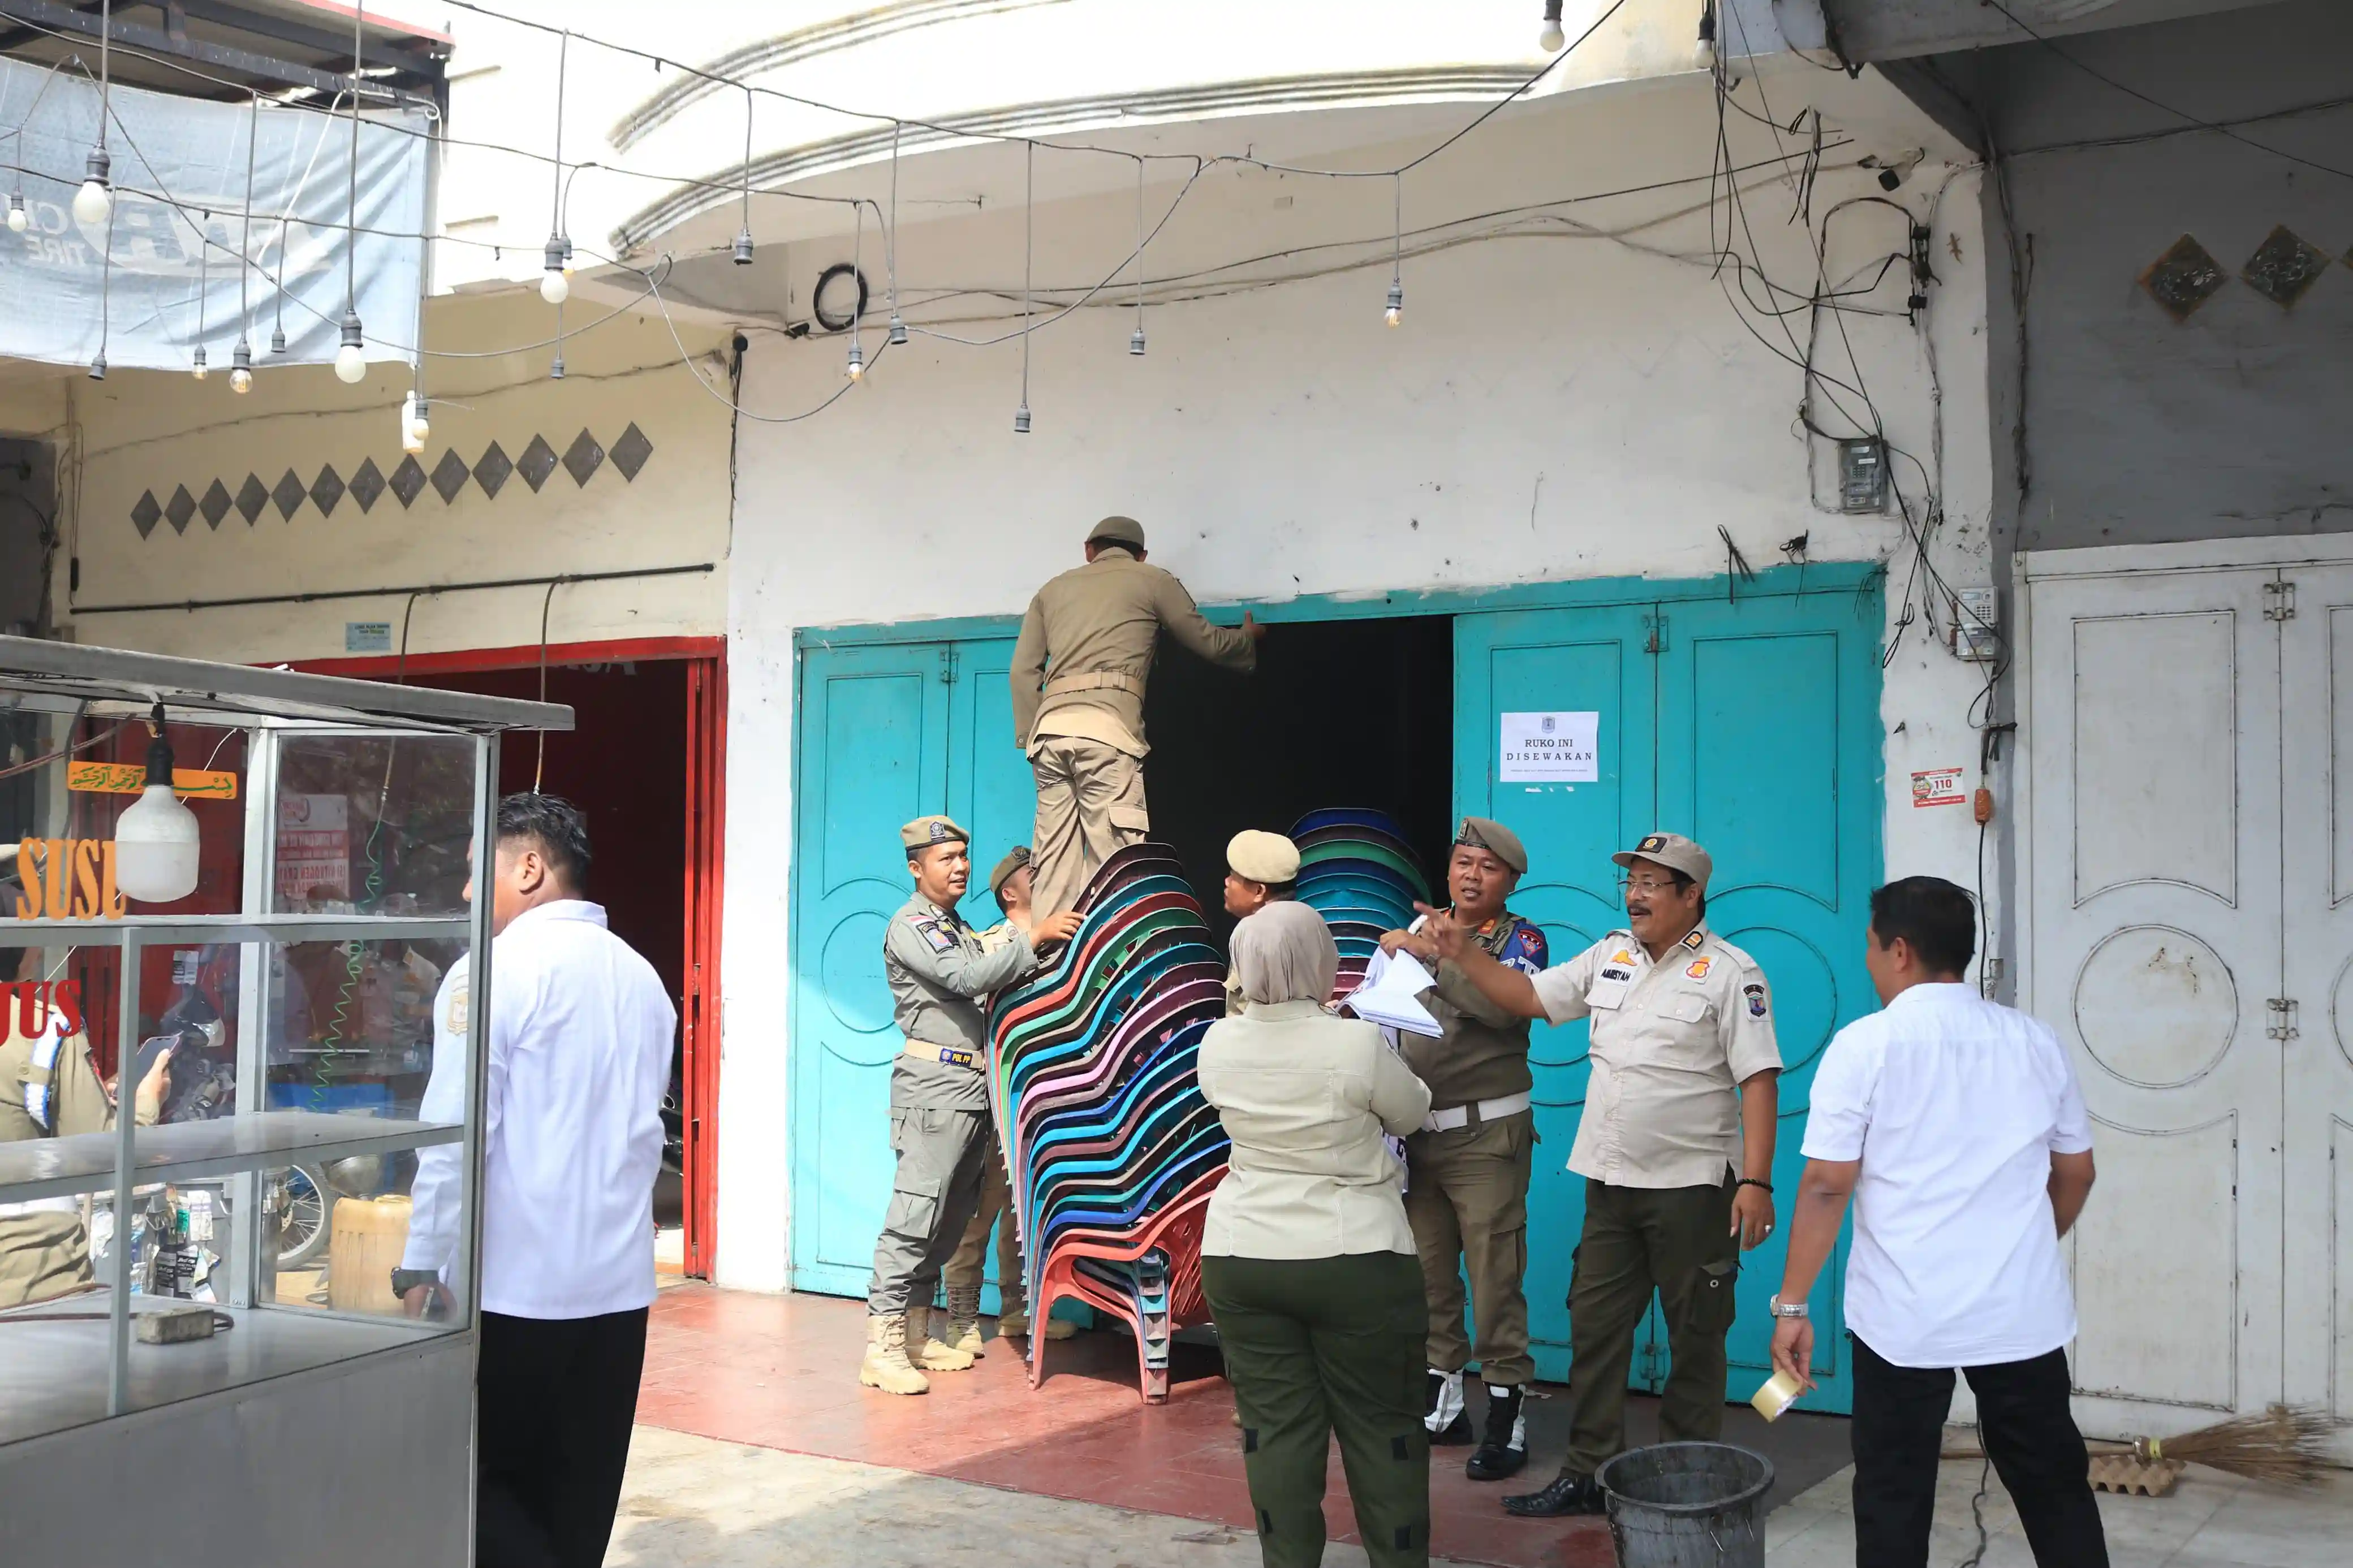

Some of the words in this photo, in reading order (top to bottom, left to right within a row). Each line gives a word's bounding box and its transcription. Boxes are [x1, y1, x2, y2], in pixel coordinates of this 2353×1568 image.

[1558, 738, 1573, 747] INI
[1506, 752, 1592, 761] DISEWAKAN
[1934, 779, 1952, 790] 110
[952, 1053, 962, 1062] POL
[963, 1055, 971, 1064] PP
